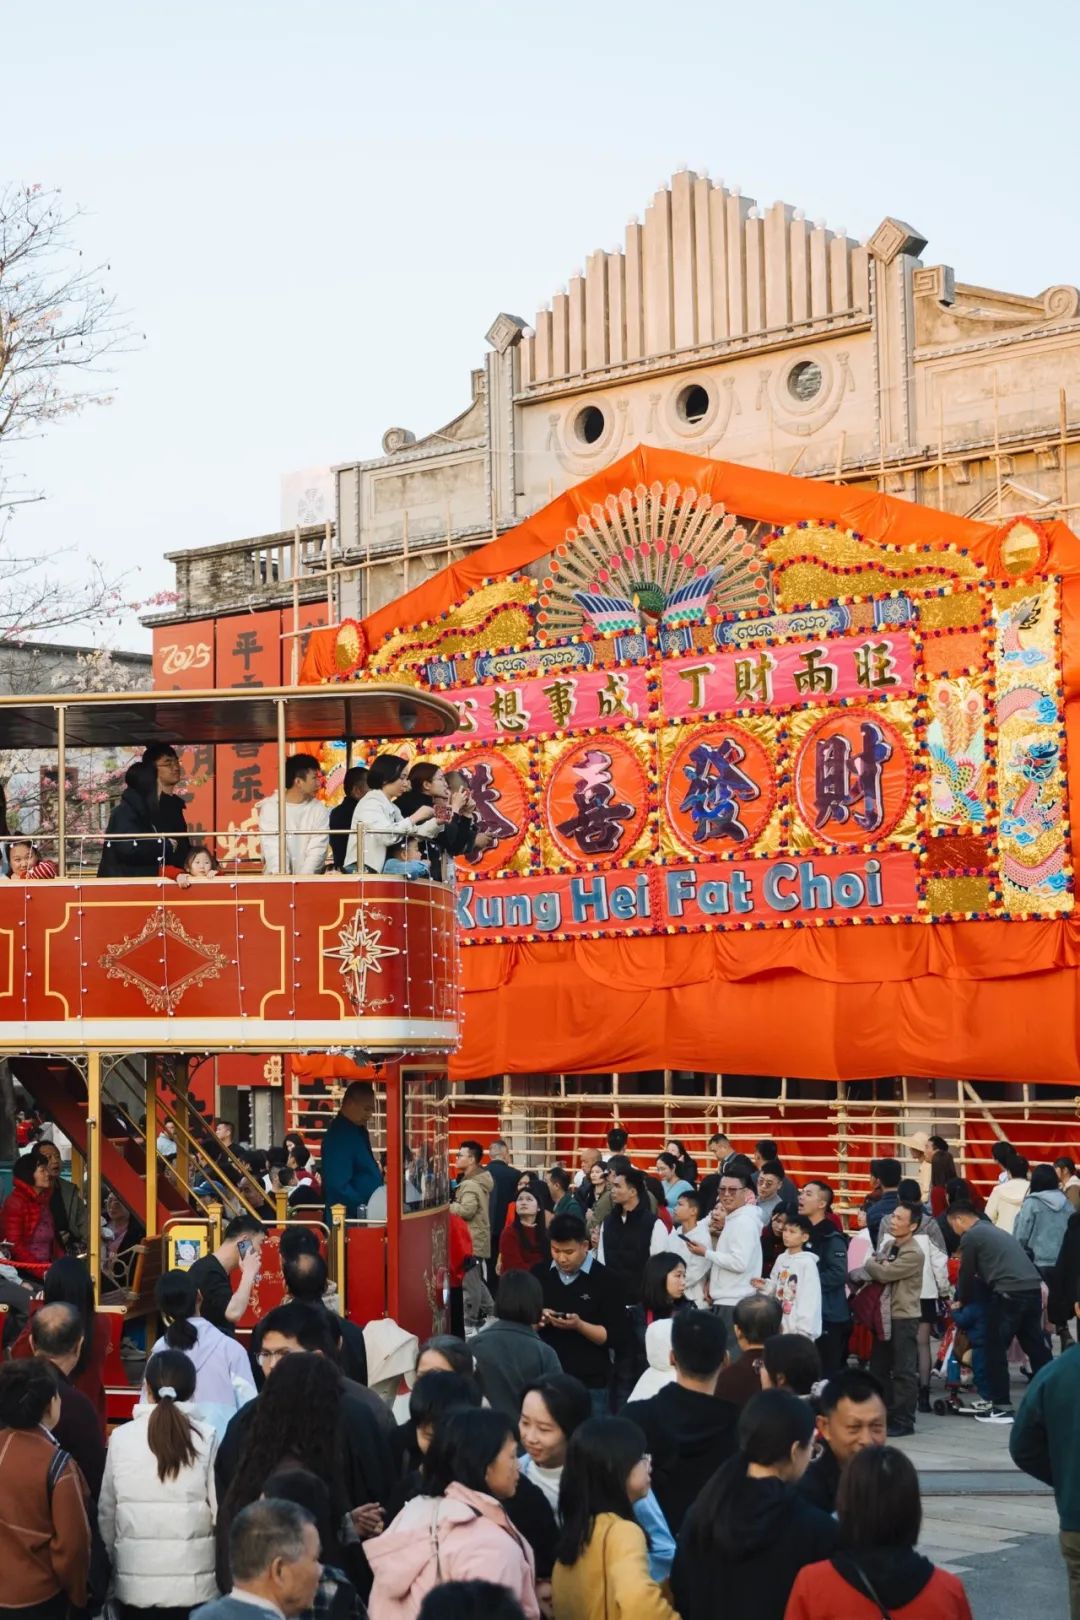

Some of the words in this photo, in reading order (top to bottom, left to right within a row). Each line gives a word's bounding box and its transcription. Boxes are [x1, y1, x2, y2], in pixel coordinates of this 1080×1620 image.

[160, 642, 212, 675] 2025
[456, 886, 561, 932] Kung
[569, 873, 650, 923] Hei
[664, 868, 754, 917] Fat
[763, 859, 884, 913] Choi
